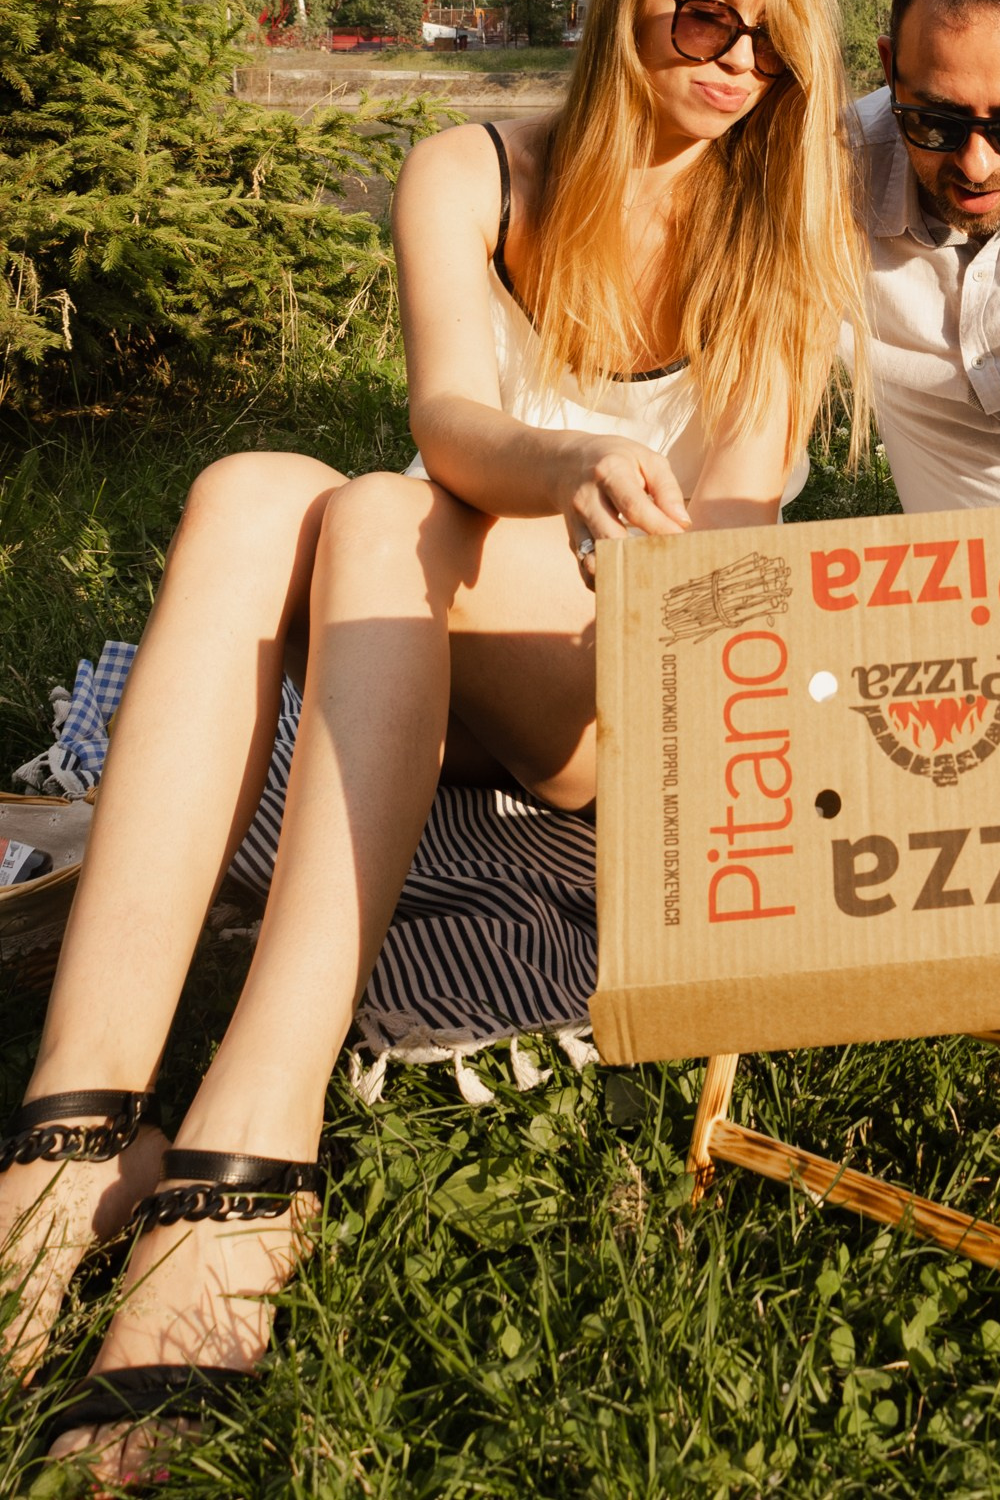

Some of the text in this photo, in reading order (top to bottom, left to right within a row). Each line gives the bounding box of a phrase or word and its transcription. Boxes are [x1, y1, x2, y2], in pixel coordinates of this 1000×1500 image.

[661, 653, 681, 927] ОСТОРОЖНО ГОРЯЧО, МОЖНО ОБЖЕЧЬСЯ
[708, 631, 796, 923] Pitano
